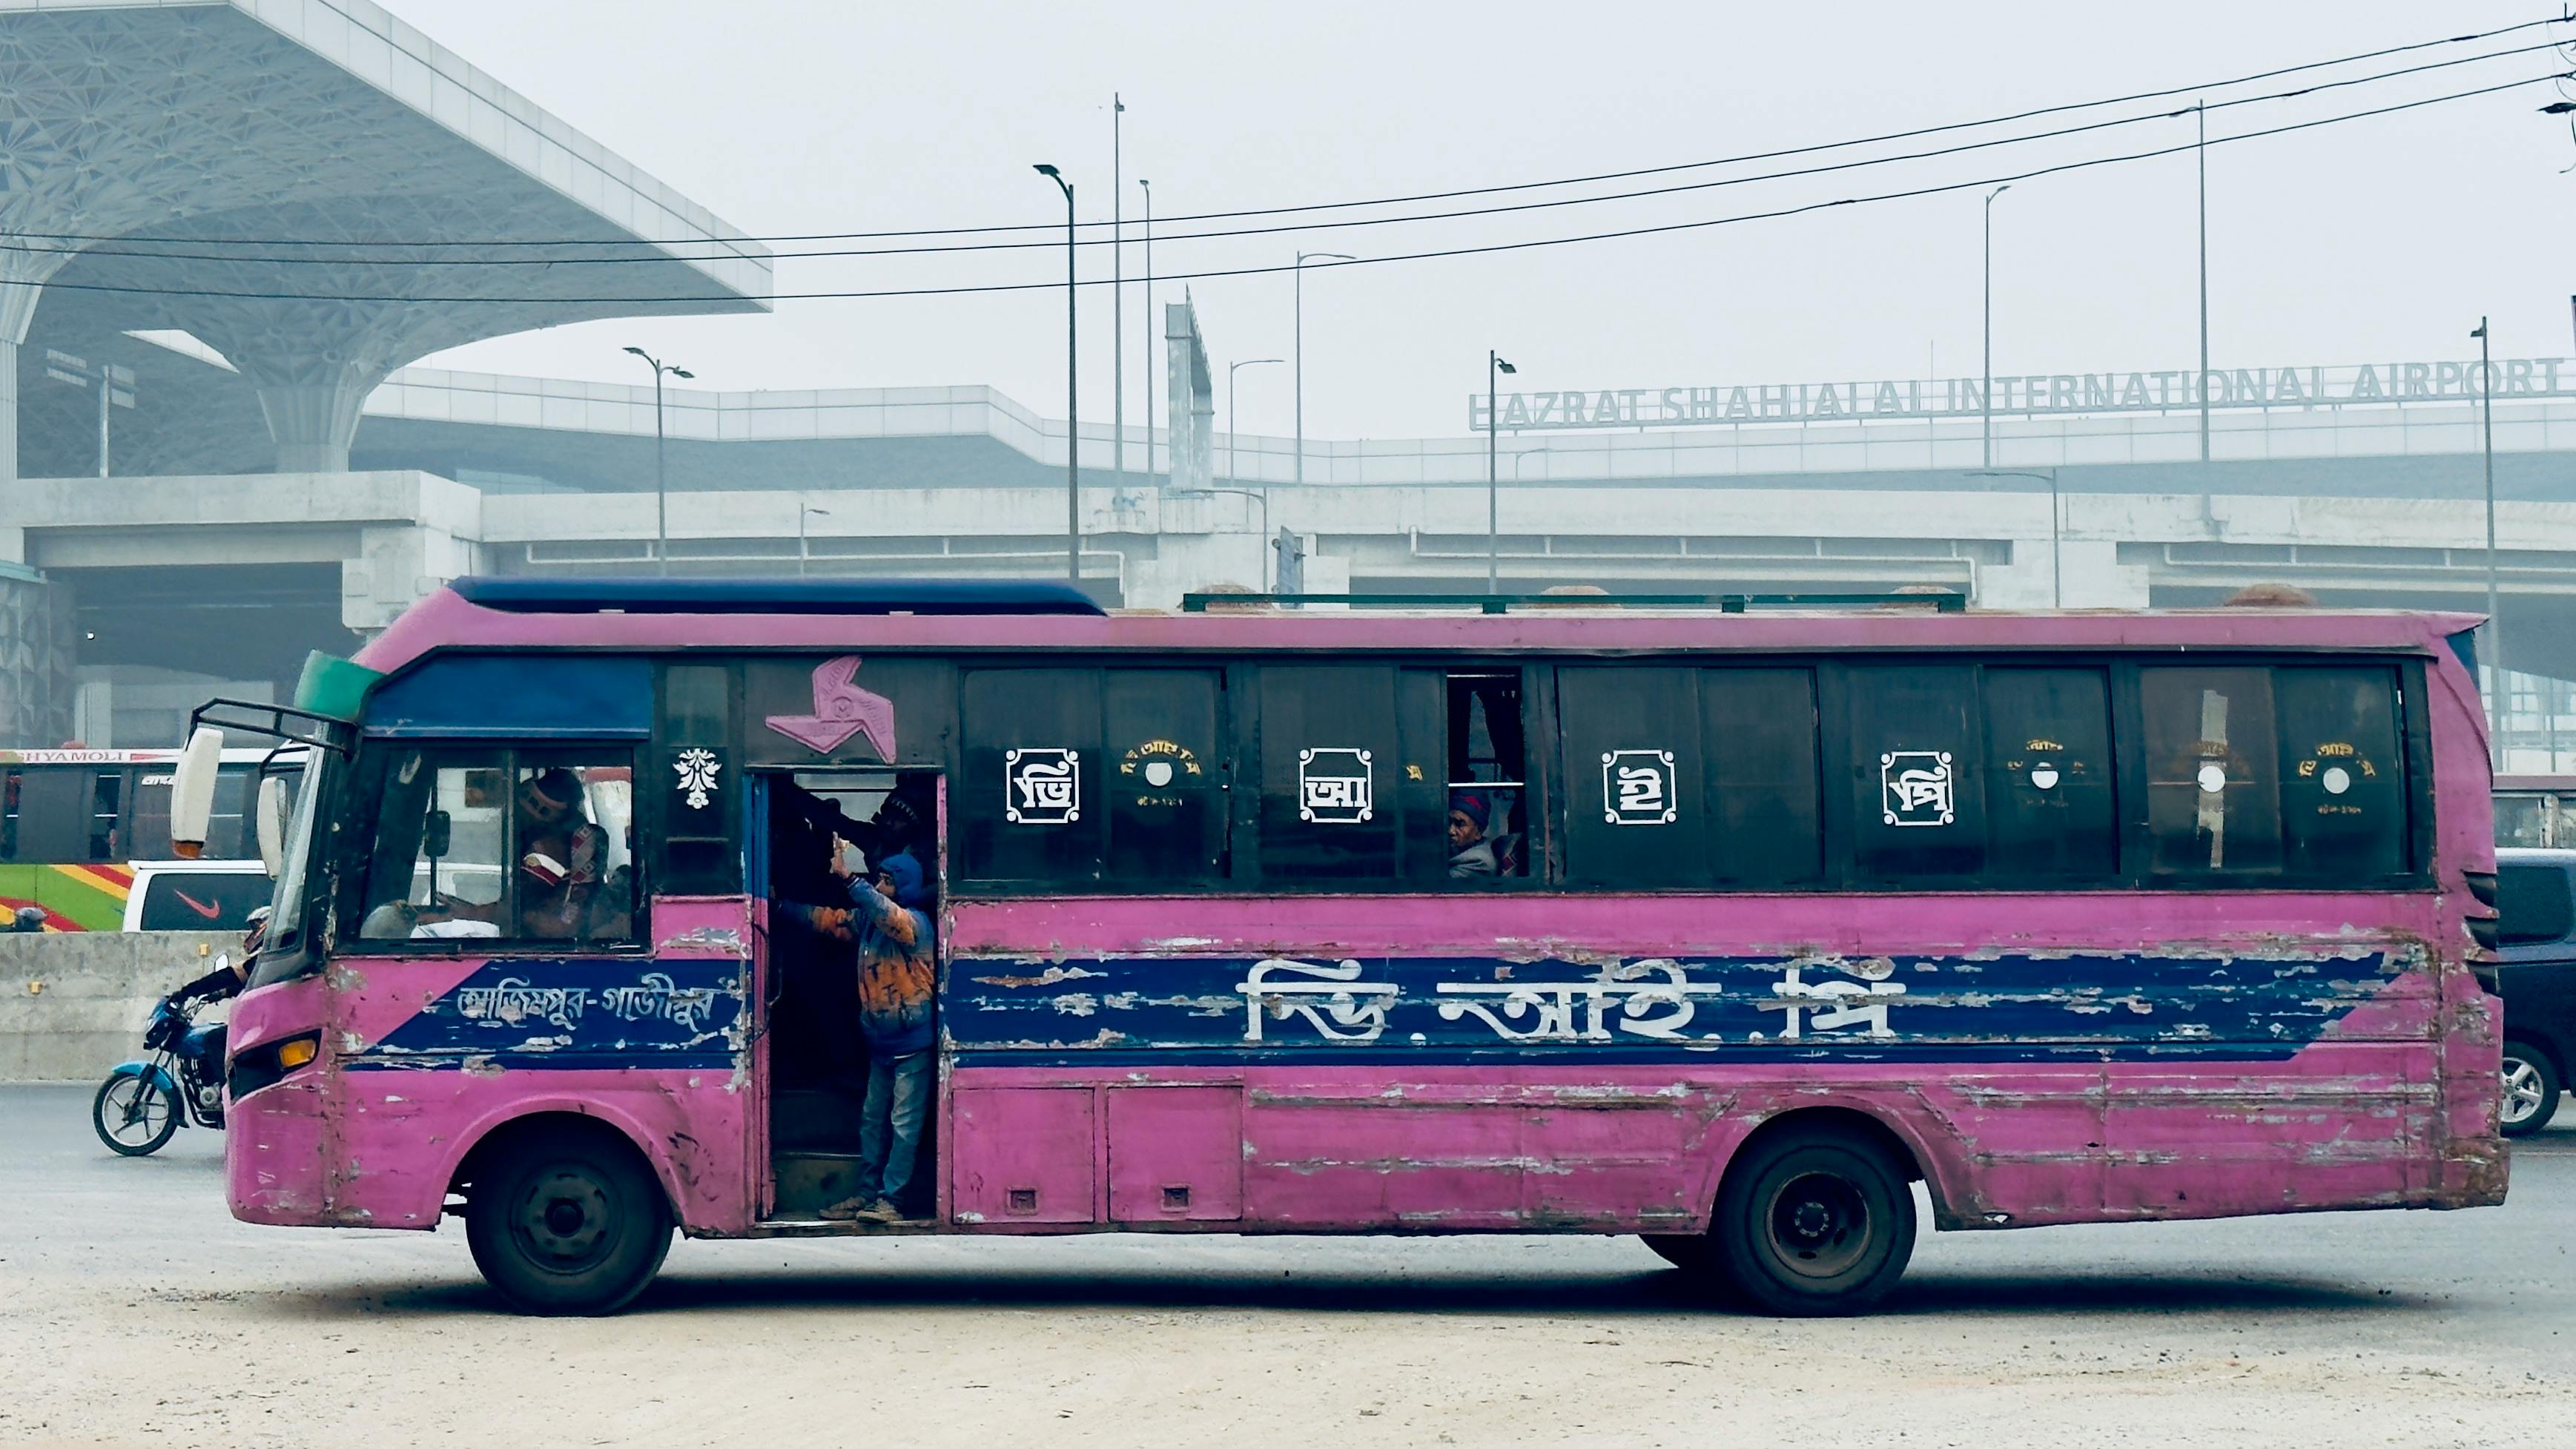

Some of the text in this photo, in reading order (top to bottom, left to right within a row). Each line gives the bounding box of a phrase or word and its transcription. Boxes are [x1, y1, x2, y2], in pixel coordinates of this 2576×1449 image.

[1469, 357, 2565, 429] HAZRAT SHAHJALAL INTERNATIONAL AIRPORT
[1014, 763, 1071, 808] ভি
[1617, 766, 1662, 810] ই
[1889, 767, 1947, 811] পি
